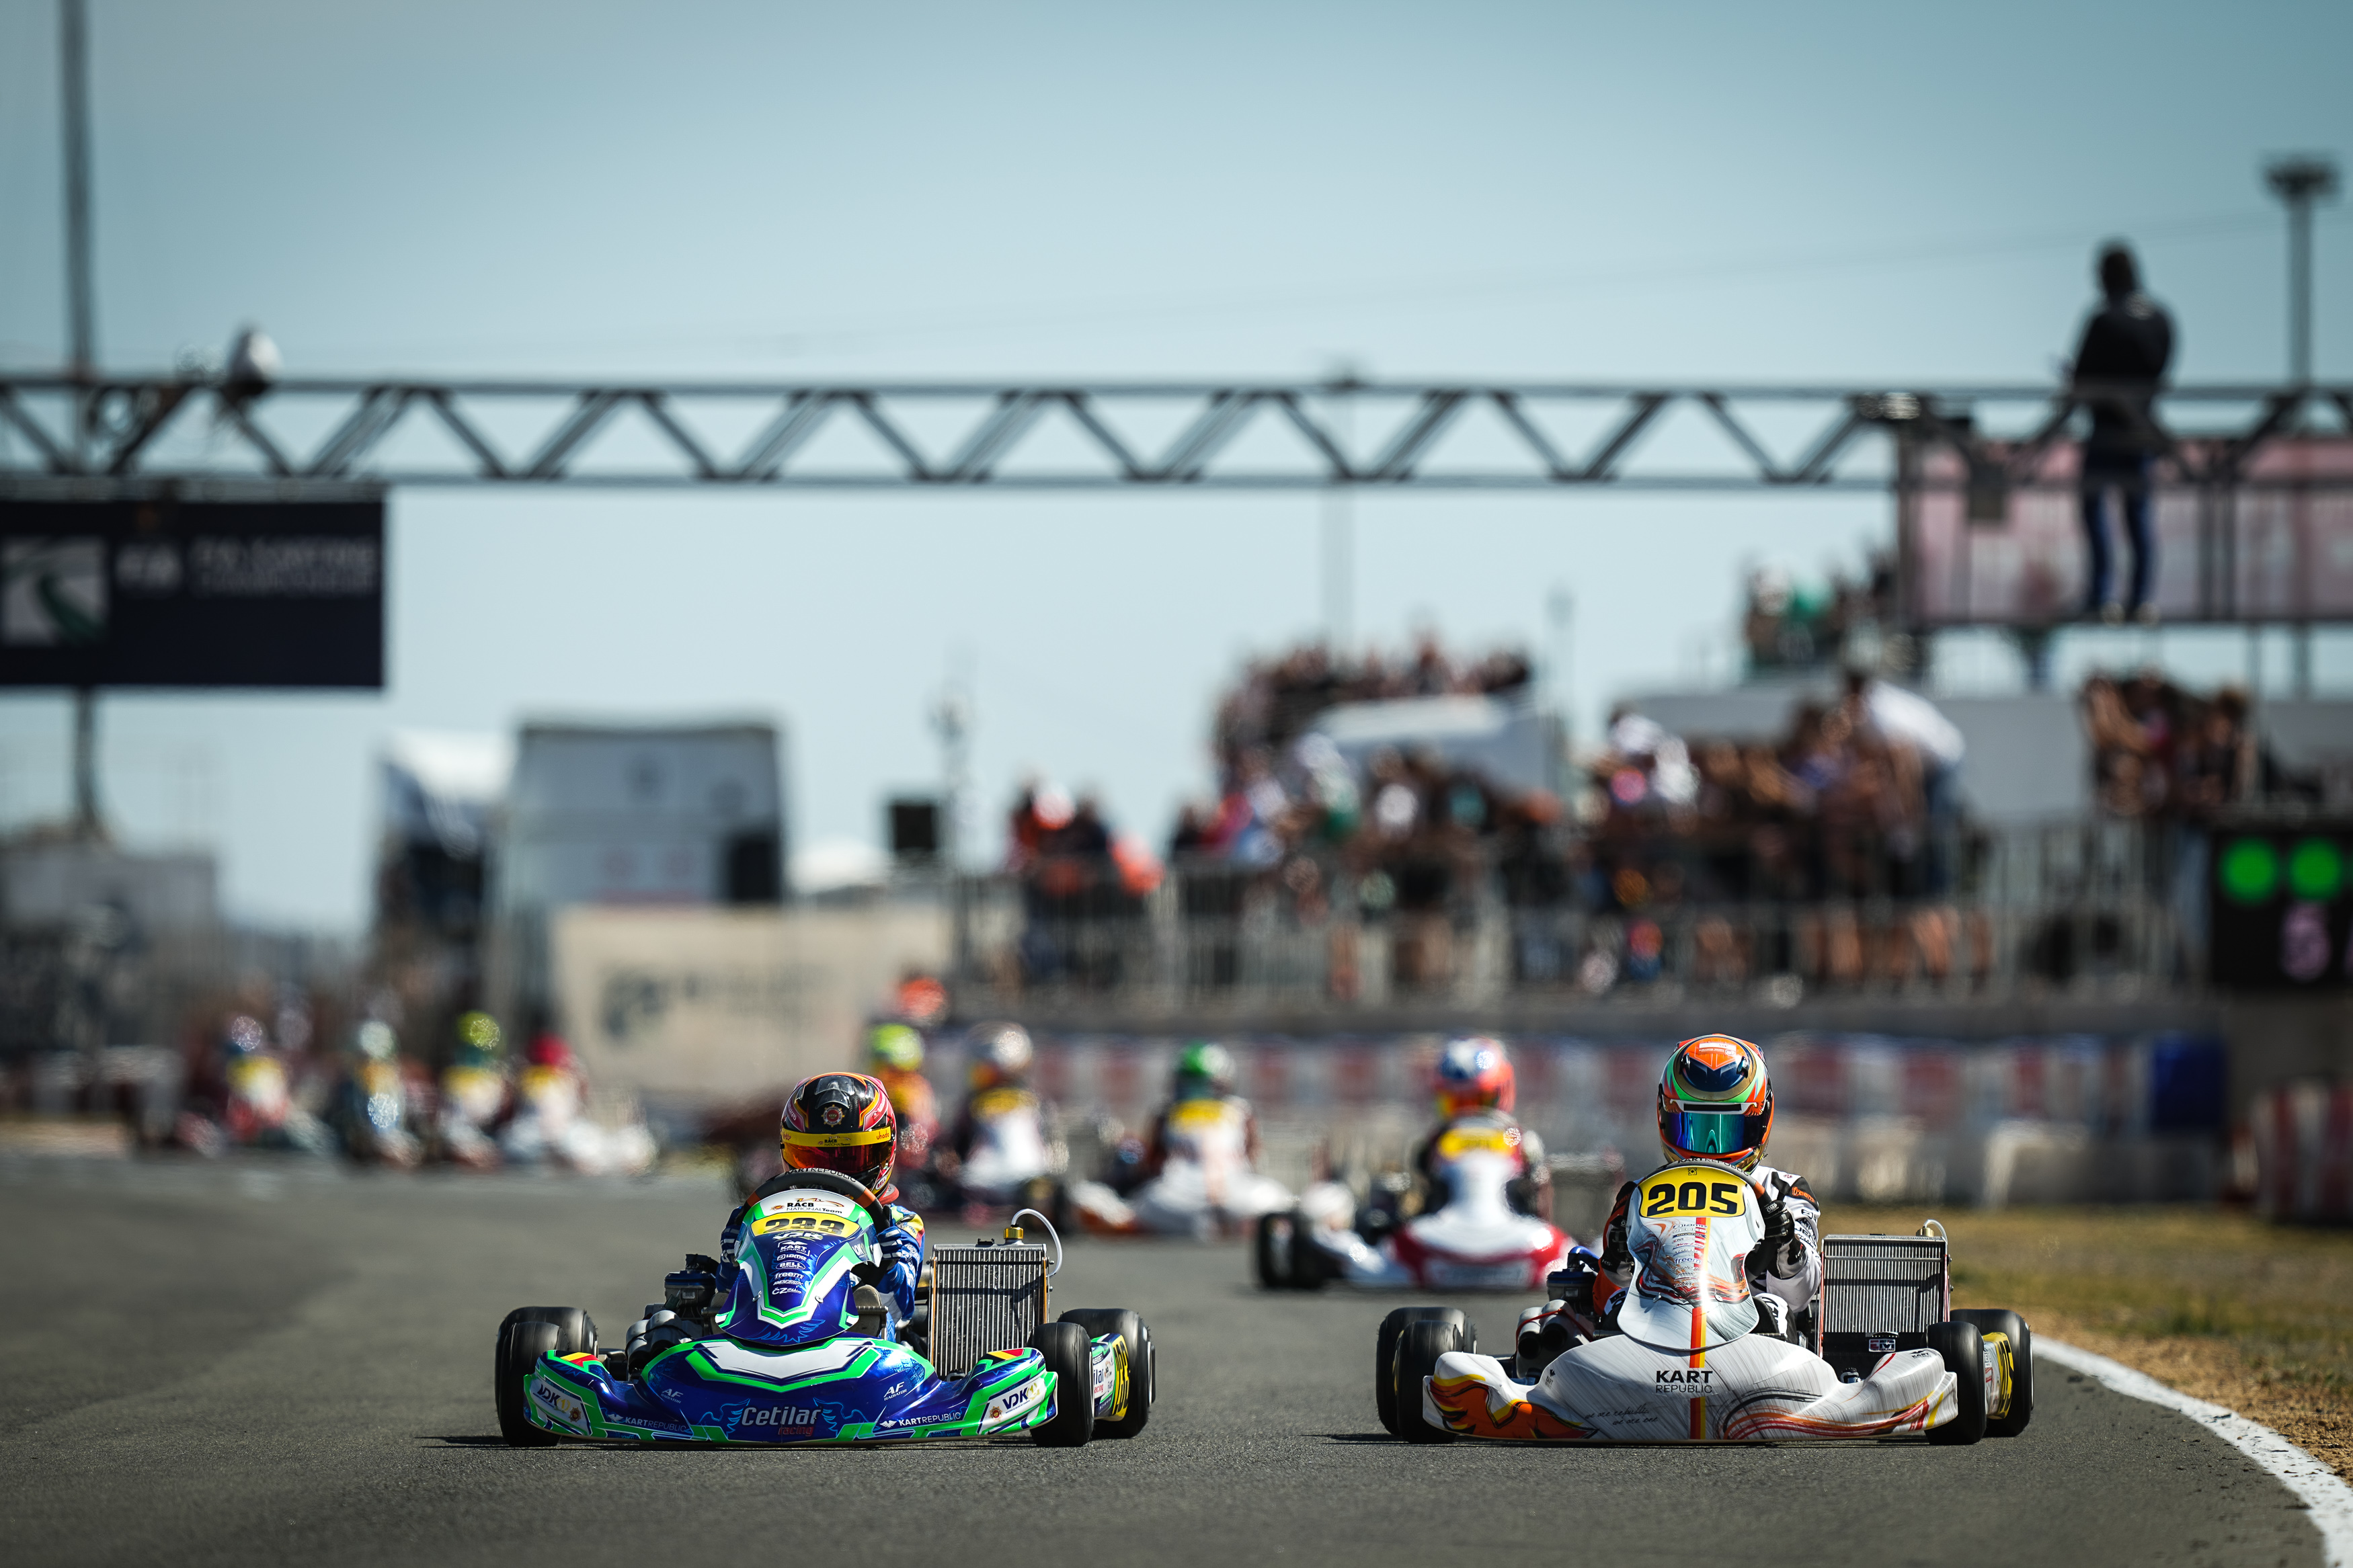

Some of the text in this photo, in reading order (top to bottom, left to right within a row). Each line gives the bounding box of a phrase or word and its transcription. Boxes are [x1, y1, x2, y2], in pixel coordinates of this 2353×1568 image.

[877, 1178, 886, 1188] BELL
[1647, 1182, 1739, 1216] 205
[1767, 1202, 1778, 1212] OMP
[763, 1217, 845, 1235] 233
[774, 1272, 805, 1280] freem
[1656, 1370, 1713, 1384] KART
[662, 1388, 684, 1398] AF
[883, 1381, 905, 1398] AF
[883, 1389, 907, 1401] RADIATOR
[1655, 1385, 1713, 1393] REPUBLIC
[660, 1393, 682, 1404] RADIATOR
[1002, 1387, 1029, 1410] VDK
[741, 1406, 822, 1426] Cetilar
[898, 1411, 961, 1426] KARTREPUBLIC
[777, 1426, 814, 1437] racing
